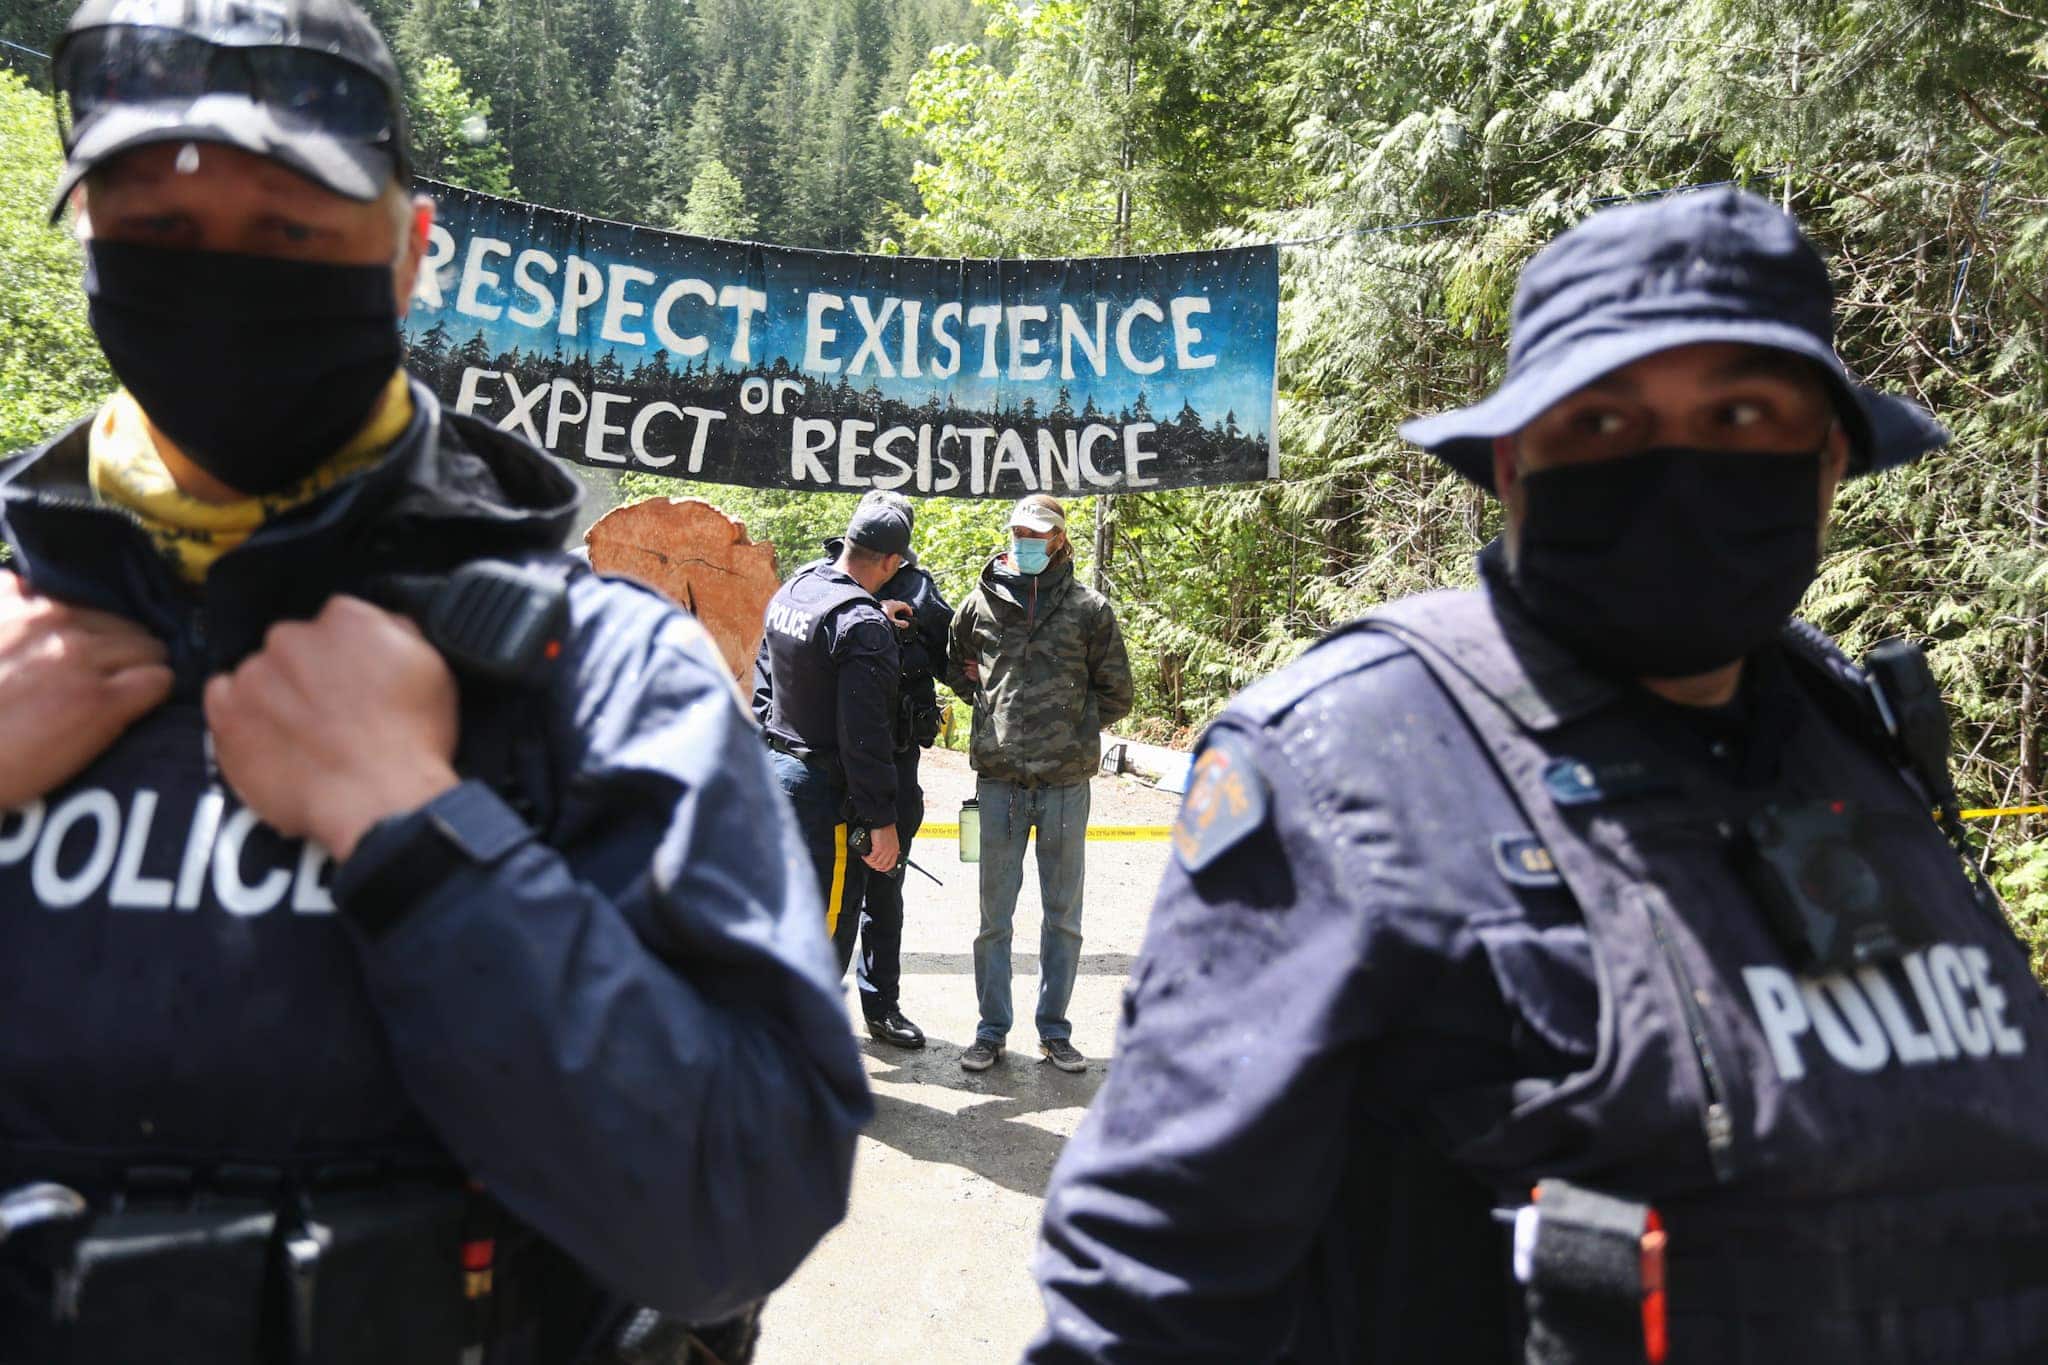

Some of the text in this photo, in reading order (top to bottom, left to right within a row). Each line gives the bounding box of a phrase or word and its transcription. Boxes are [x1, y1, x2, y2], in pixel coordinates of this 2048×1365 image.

[414, 223, 1218, 381] RESPECT EXISTENCE
[455, 367, 1159, 496] EXPECT RESISTANCE
[740, 377, 806, 415] or
[766, 602, 812, 641] POLICE
[1741, 943, 2026, 1081] POLICE
